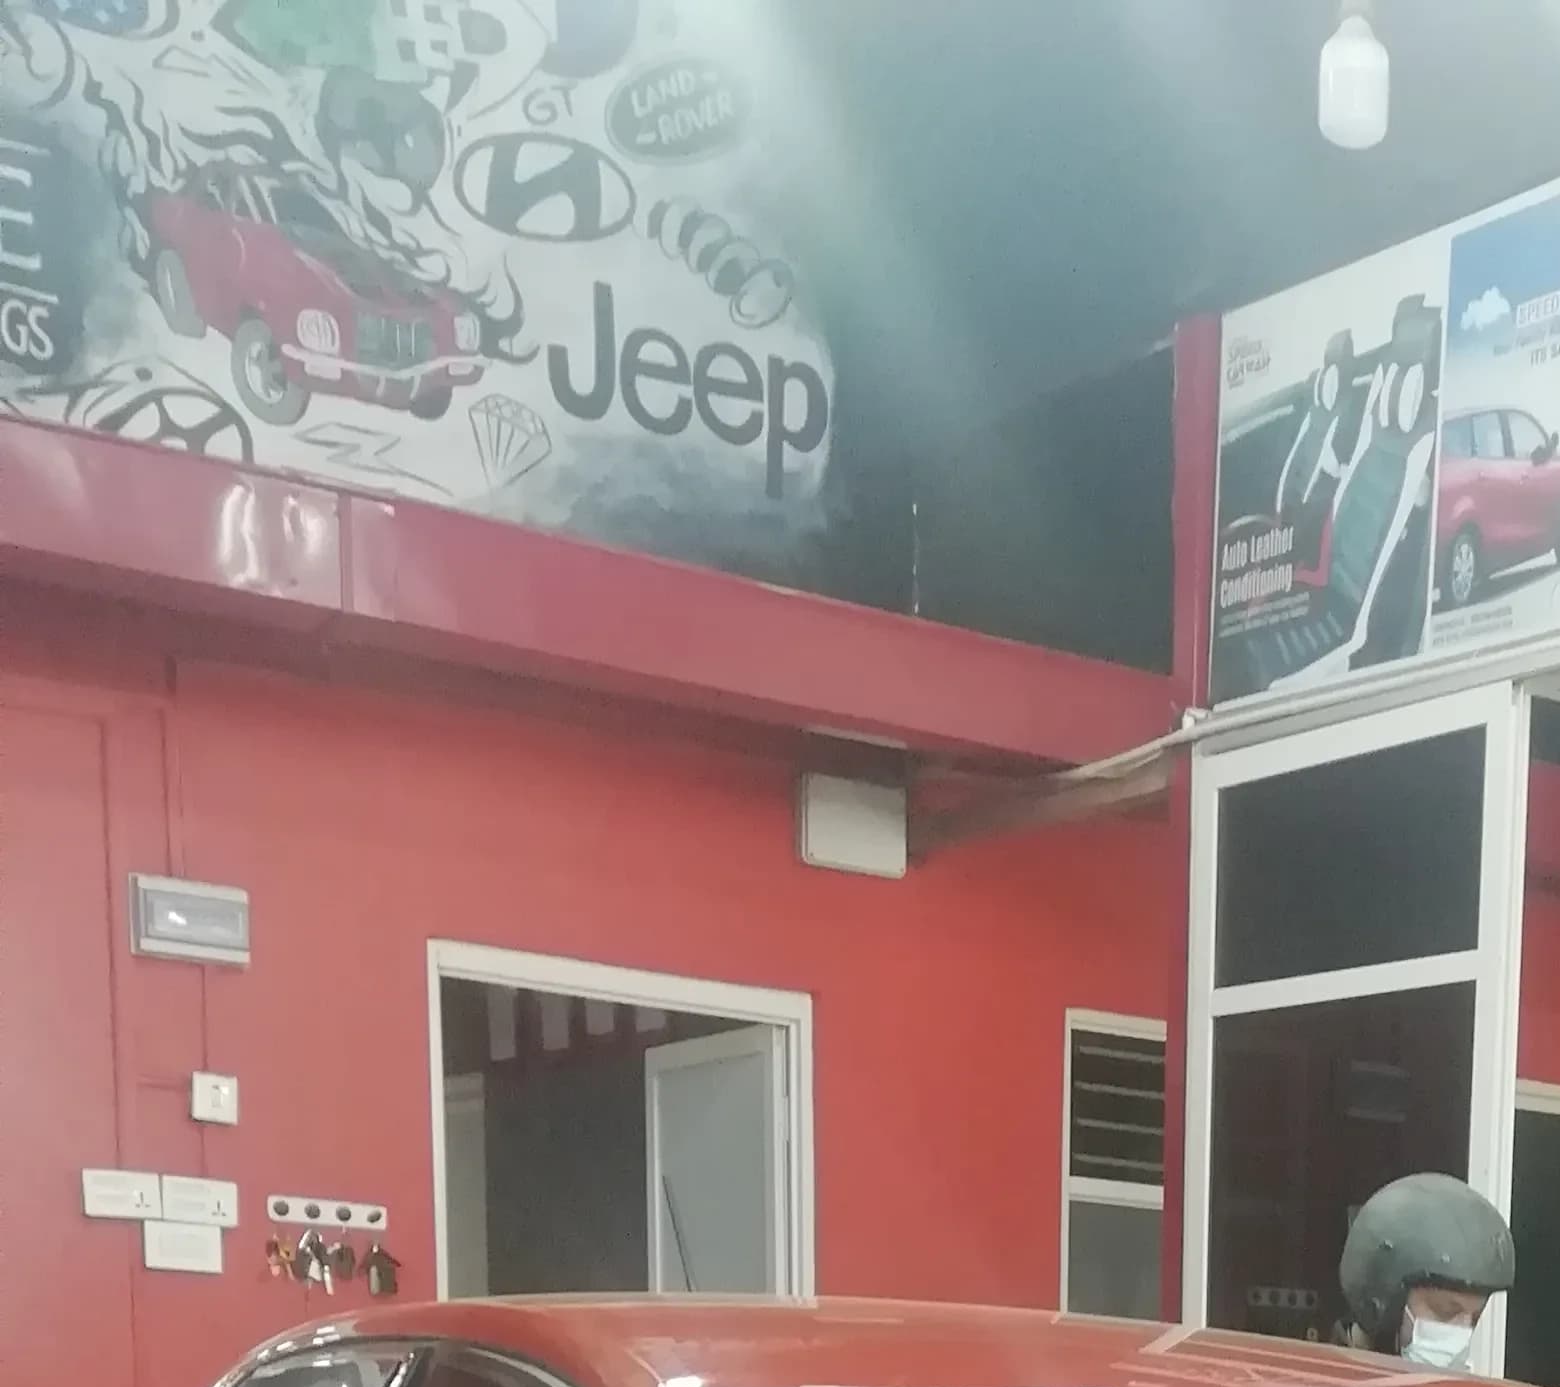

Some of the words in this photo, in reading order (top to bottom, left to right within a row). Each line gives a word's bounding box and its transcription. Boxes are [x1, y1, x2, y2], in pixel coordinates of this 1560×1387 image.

[630, 69, 695, 118] LAND
[656, 90, 735, 145] ROVER
[547, 280, 829, 500] Jeep
[1221, 540, 1248, 571] Auto
[1250, 525, 1294, 563] Leather
[1220, 563, 1293, 609] Conditioning
